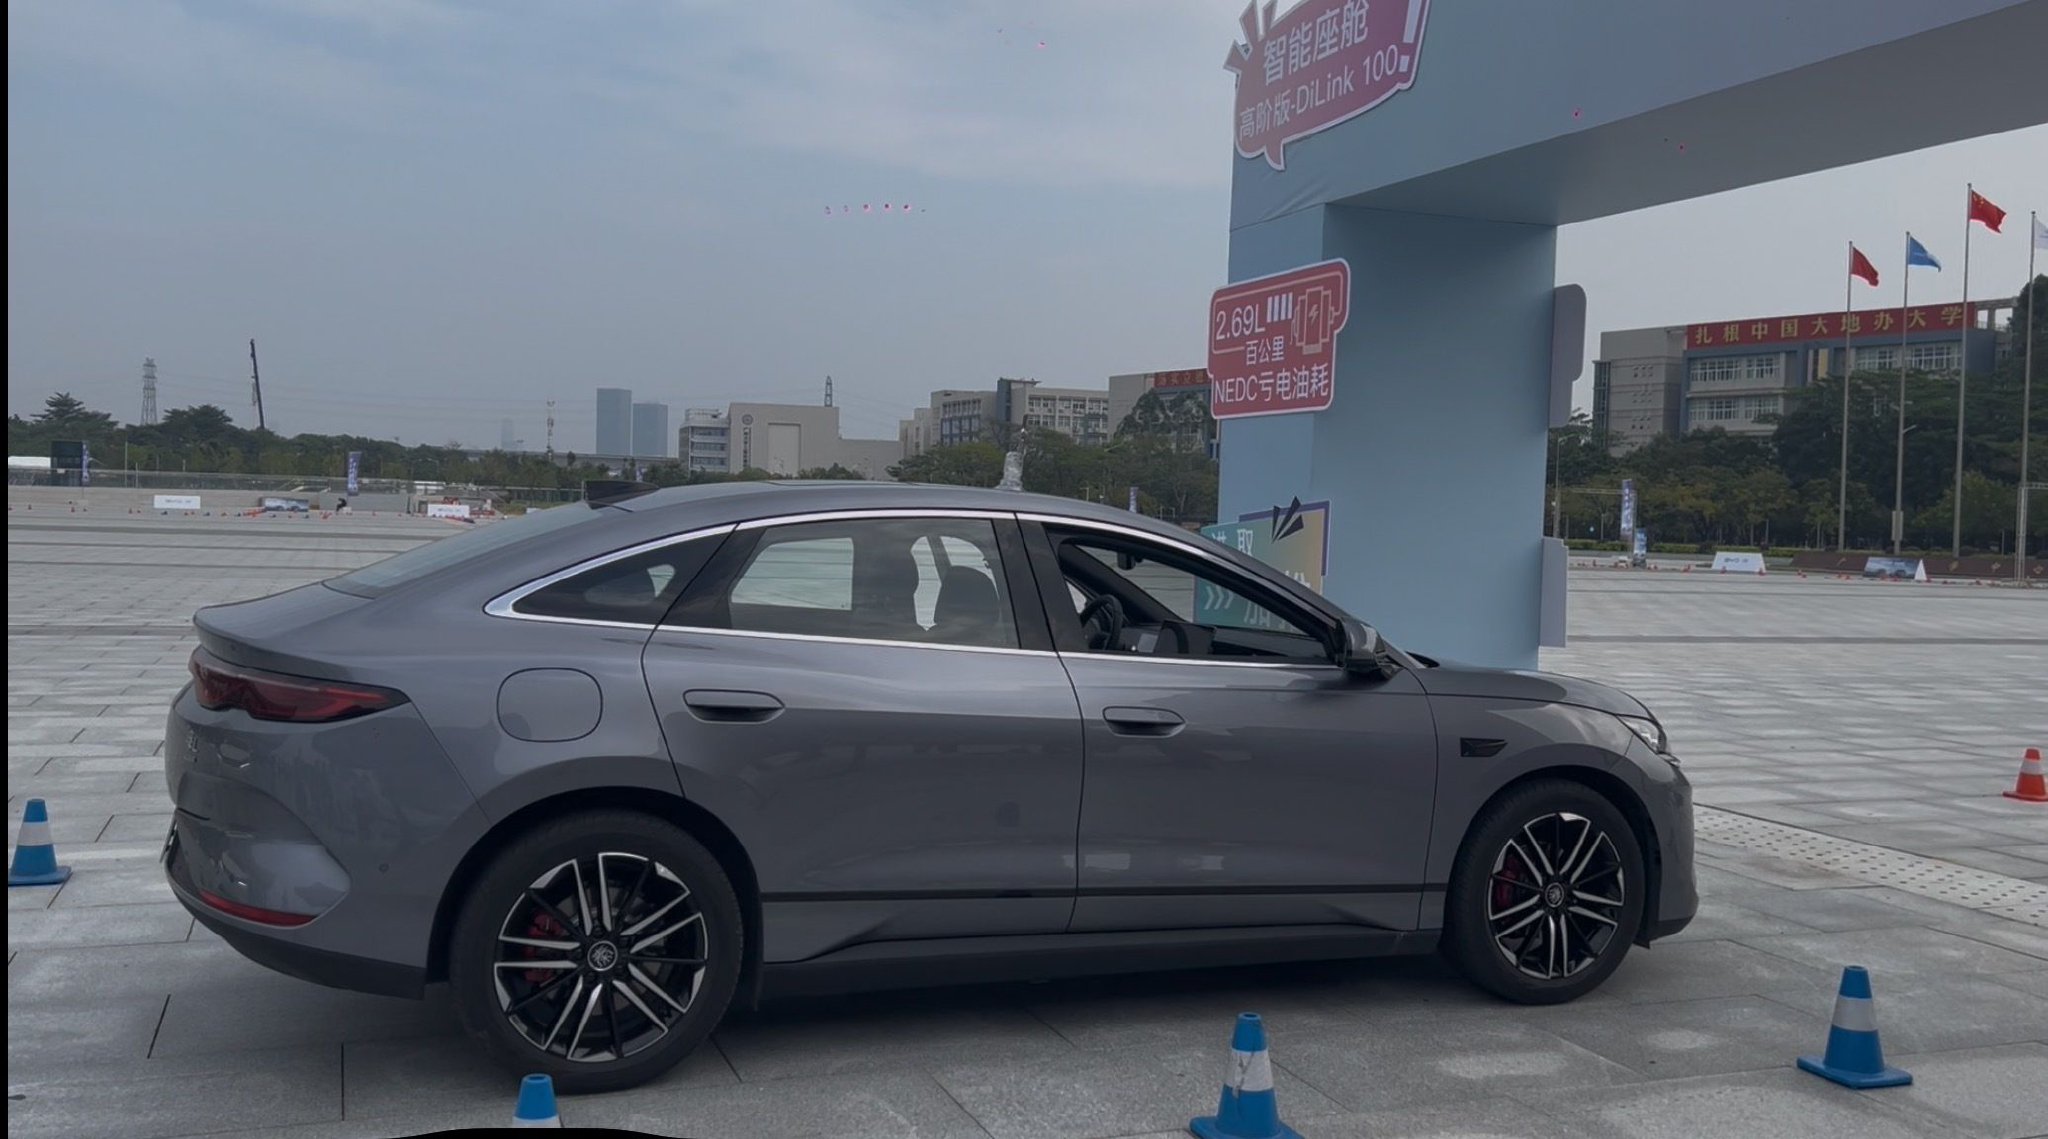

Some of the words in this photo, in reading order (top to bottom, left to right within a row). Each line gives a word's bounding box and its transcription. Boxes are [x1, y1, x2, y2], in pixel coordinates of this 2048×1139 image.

[1263, 0, 1369, 86] 智能座舱
[1239, 66, 1355, 141] 高阶版-DiLink
[1362, 44, 1399, 85] 100
[1216, 303, 1266, 341] 2.69L
[1695, 306, 1963, 344] 扎根中国大地办大学
[1246, 336, 1285, 365] 百公里
[1215, 362, 1329, 404] NEDC亏电油耗
